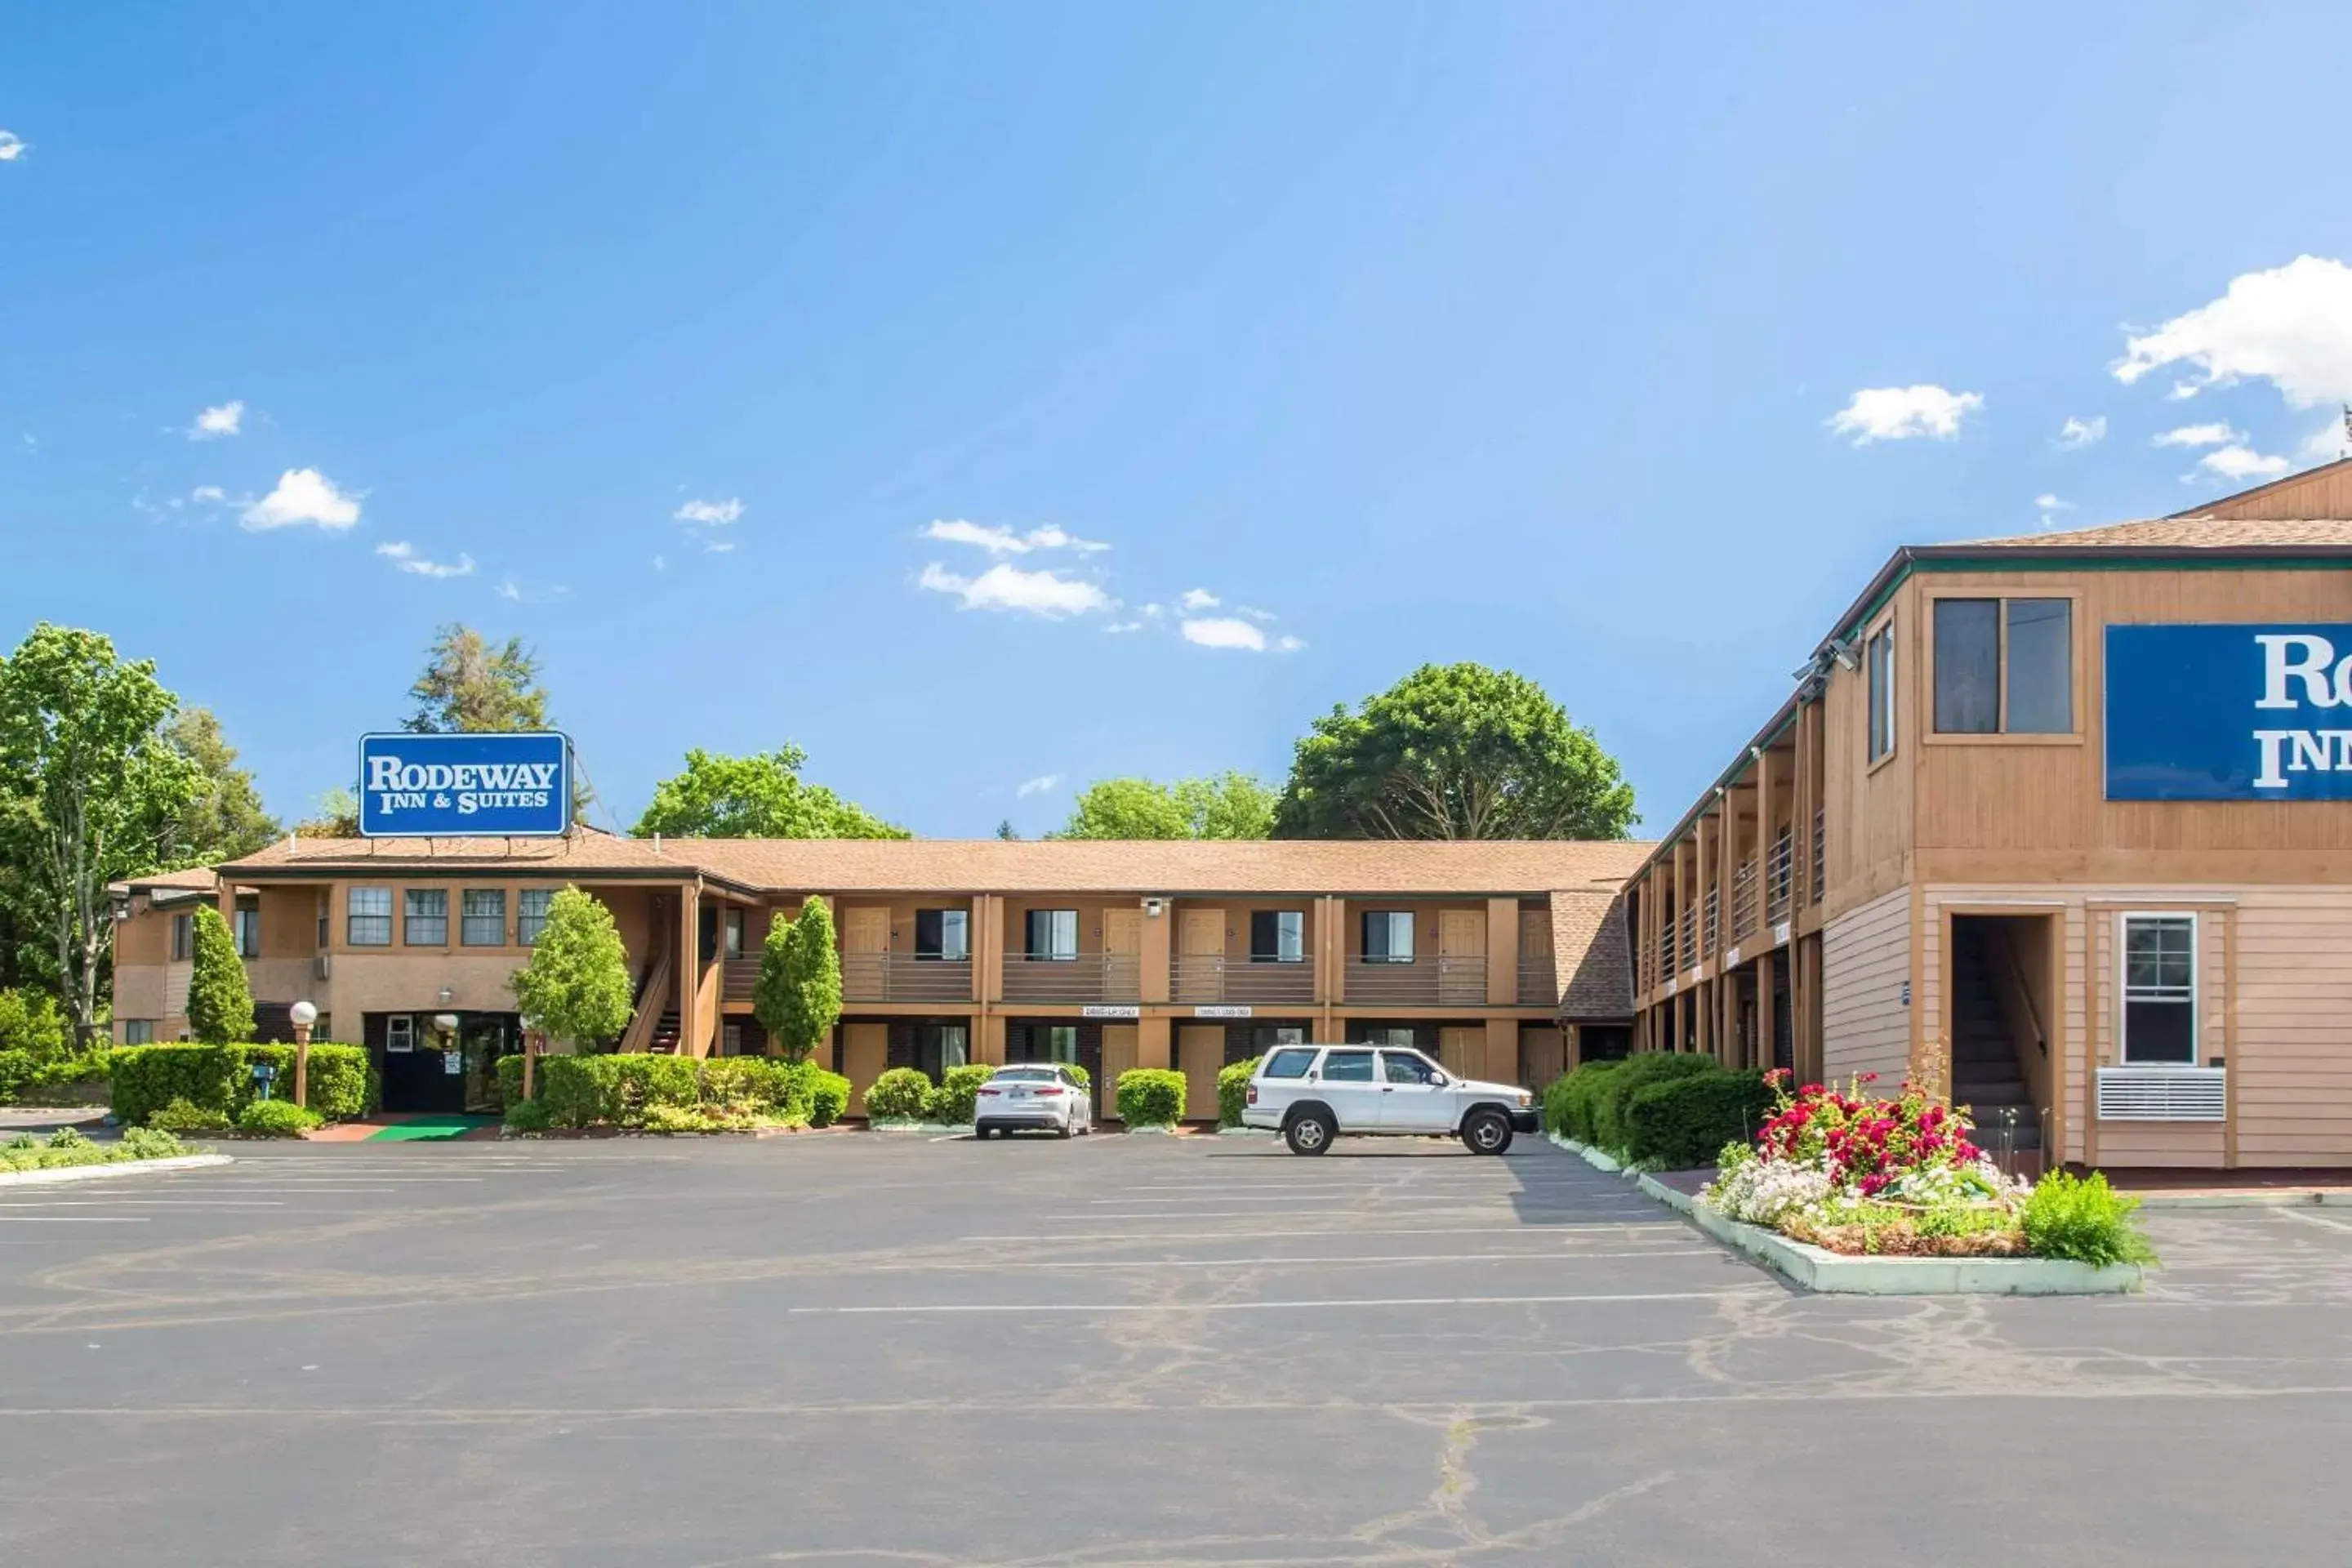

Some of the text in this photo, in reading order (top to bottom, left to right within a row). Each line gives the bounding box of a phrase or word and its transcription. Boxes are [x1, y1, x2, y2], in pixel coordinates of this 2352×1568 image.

[368, 755, 559, 791] RODEWAY
[380, 791, 549, 814] INN & SUITES
